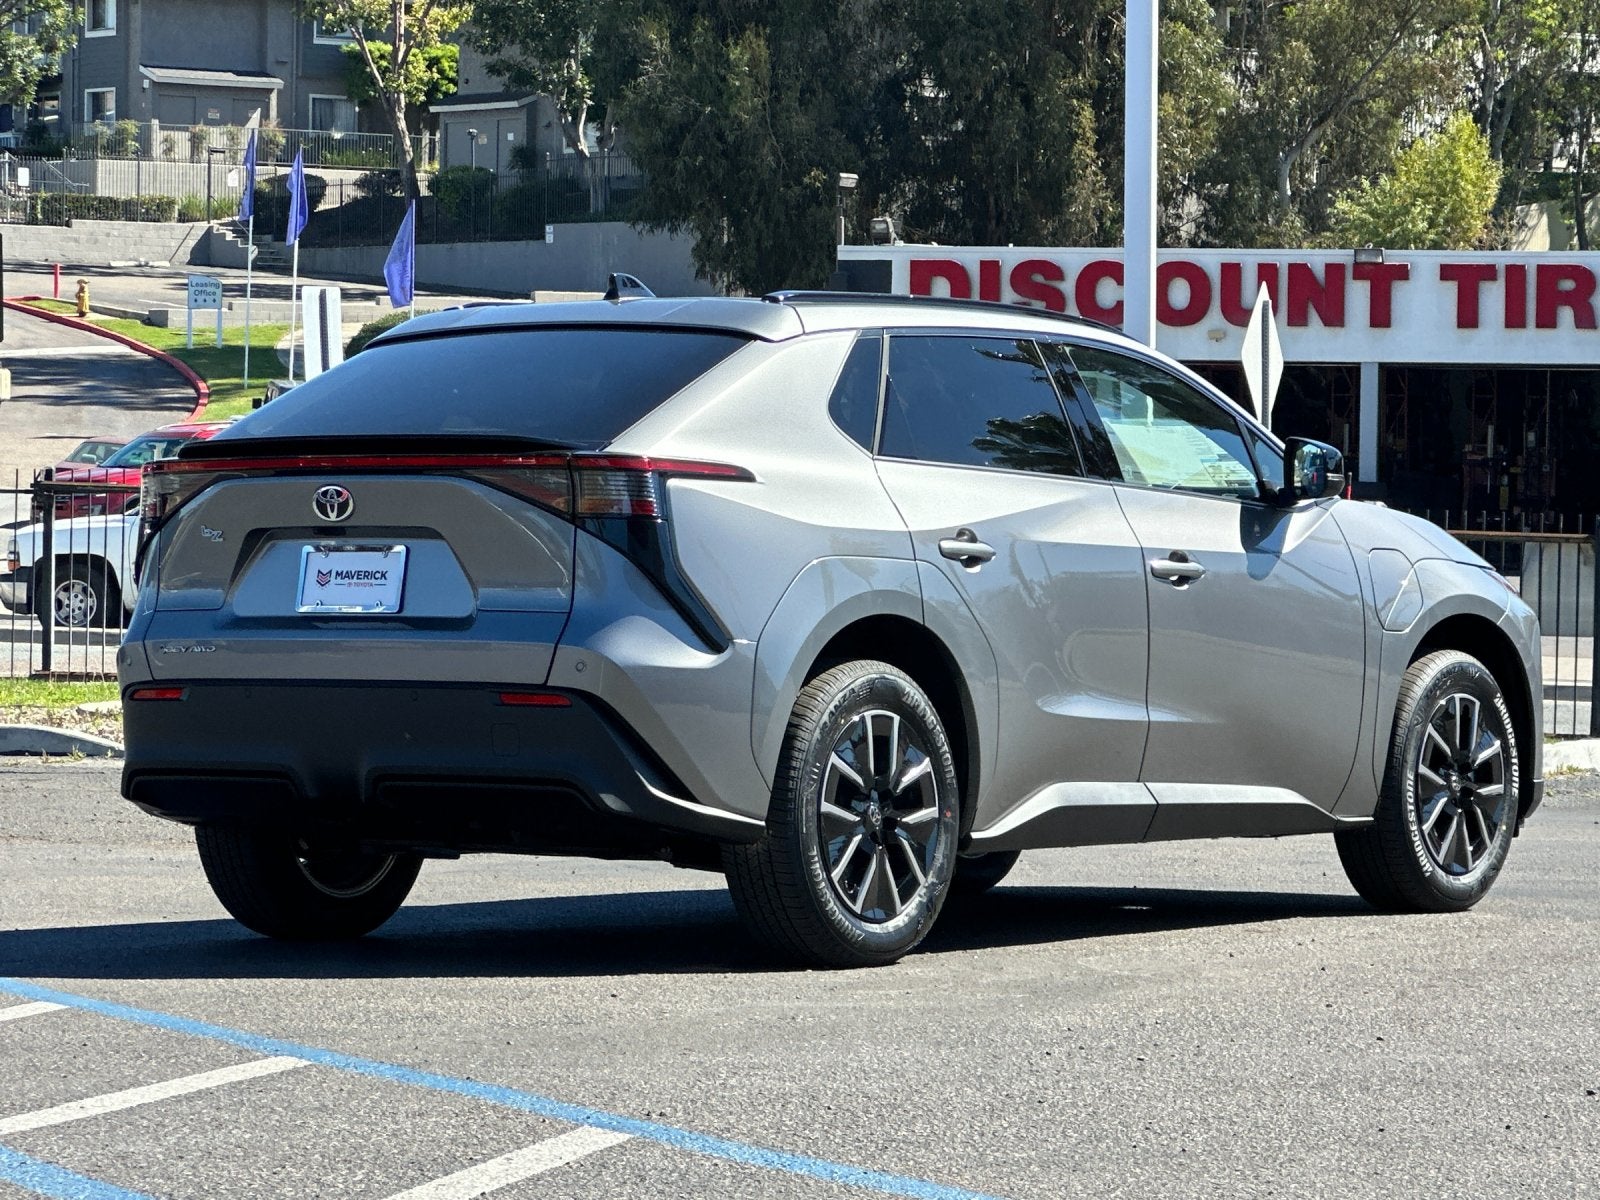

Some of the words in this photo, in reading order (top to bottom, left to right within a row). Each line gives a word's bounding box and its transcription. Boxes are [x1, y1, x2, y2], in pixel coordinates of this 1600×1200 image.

[190, 280, 220, 289] Leasing
[910, 259, 1411, 329] DISCOUNT
[334, 569, 389, 581] MAVERICK
[902, 687, 957, 788] BRIDGESTONE
[1493, 692, 1520, 798] BRIDGESTONE
[1406, 769, 1433, 878] BRIDGESTONE
